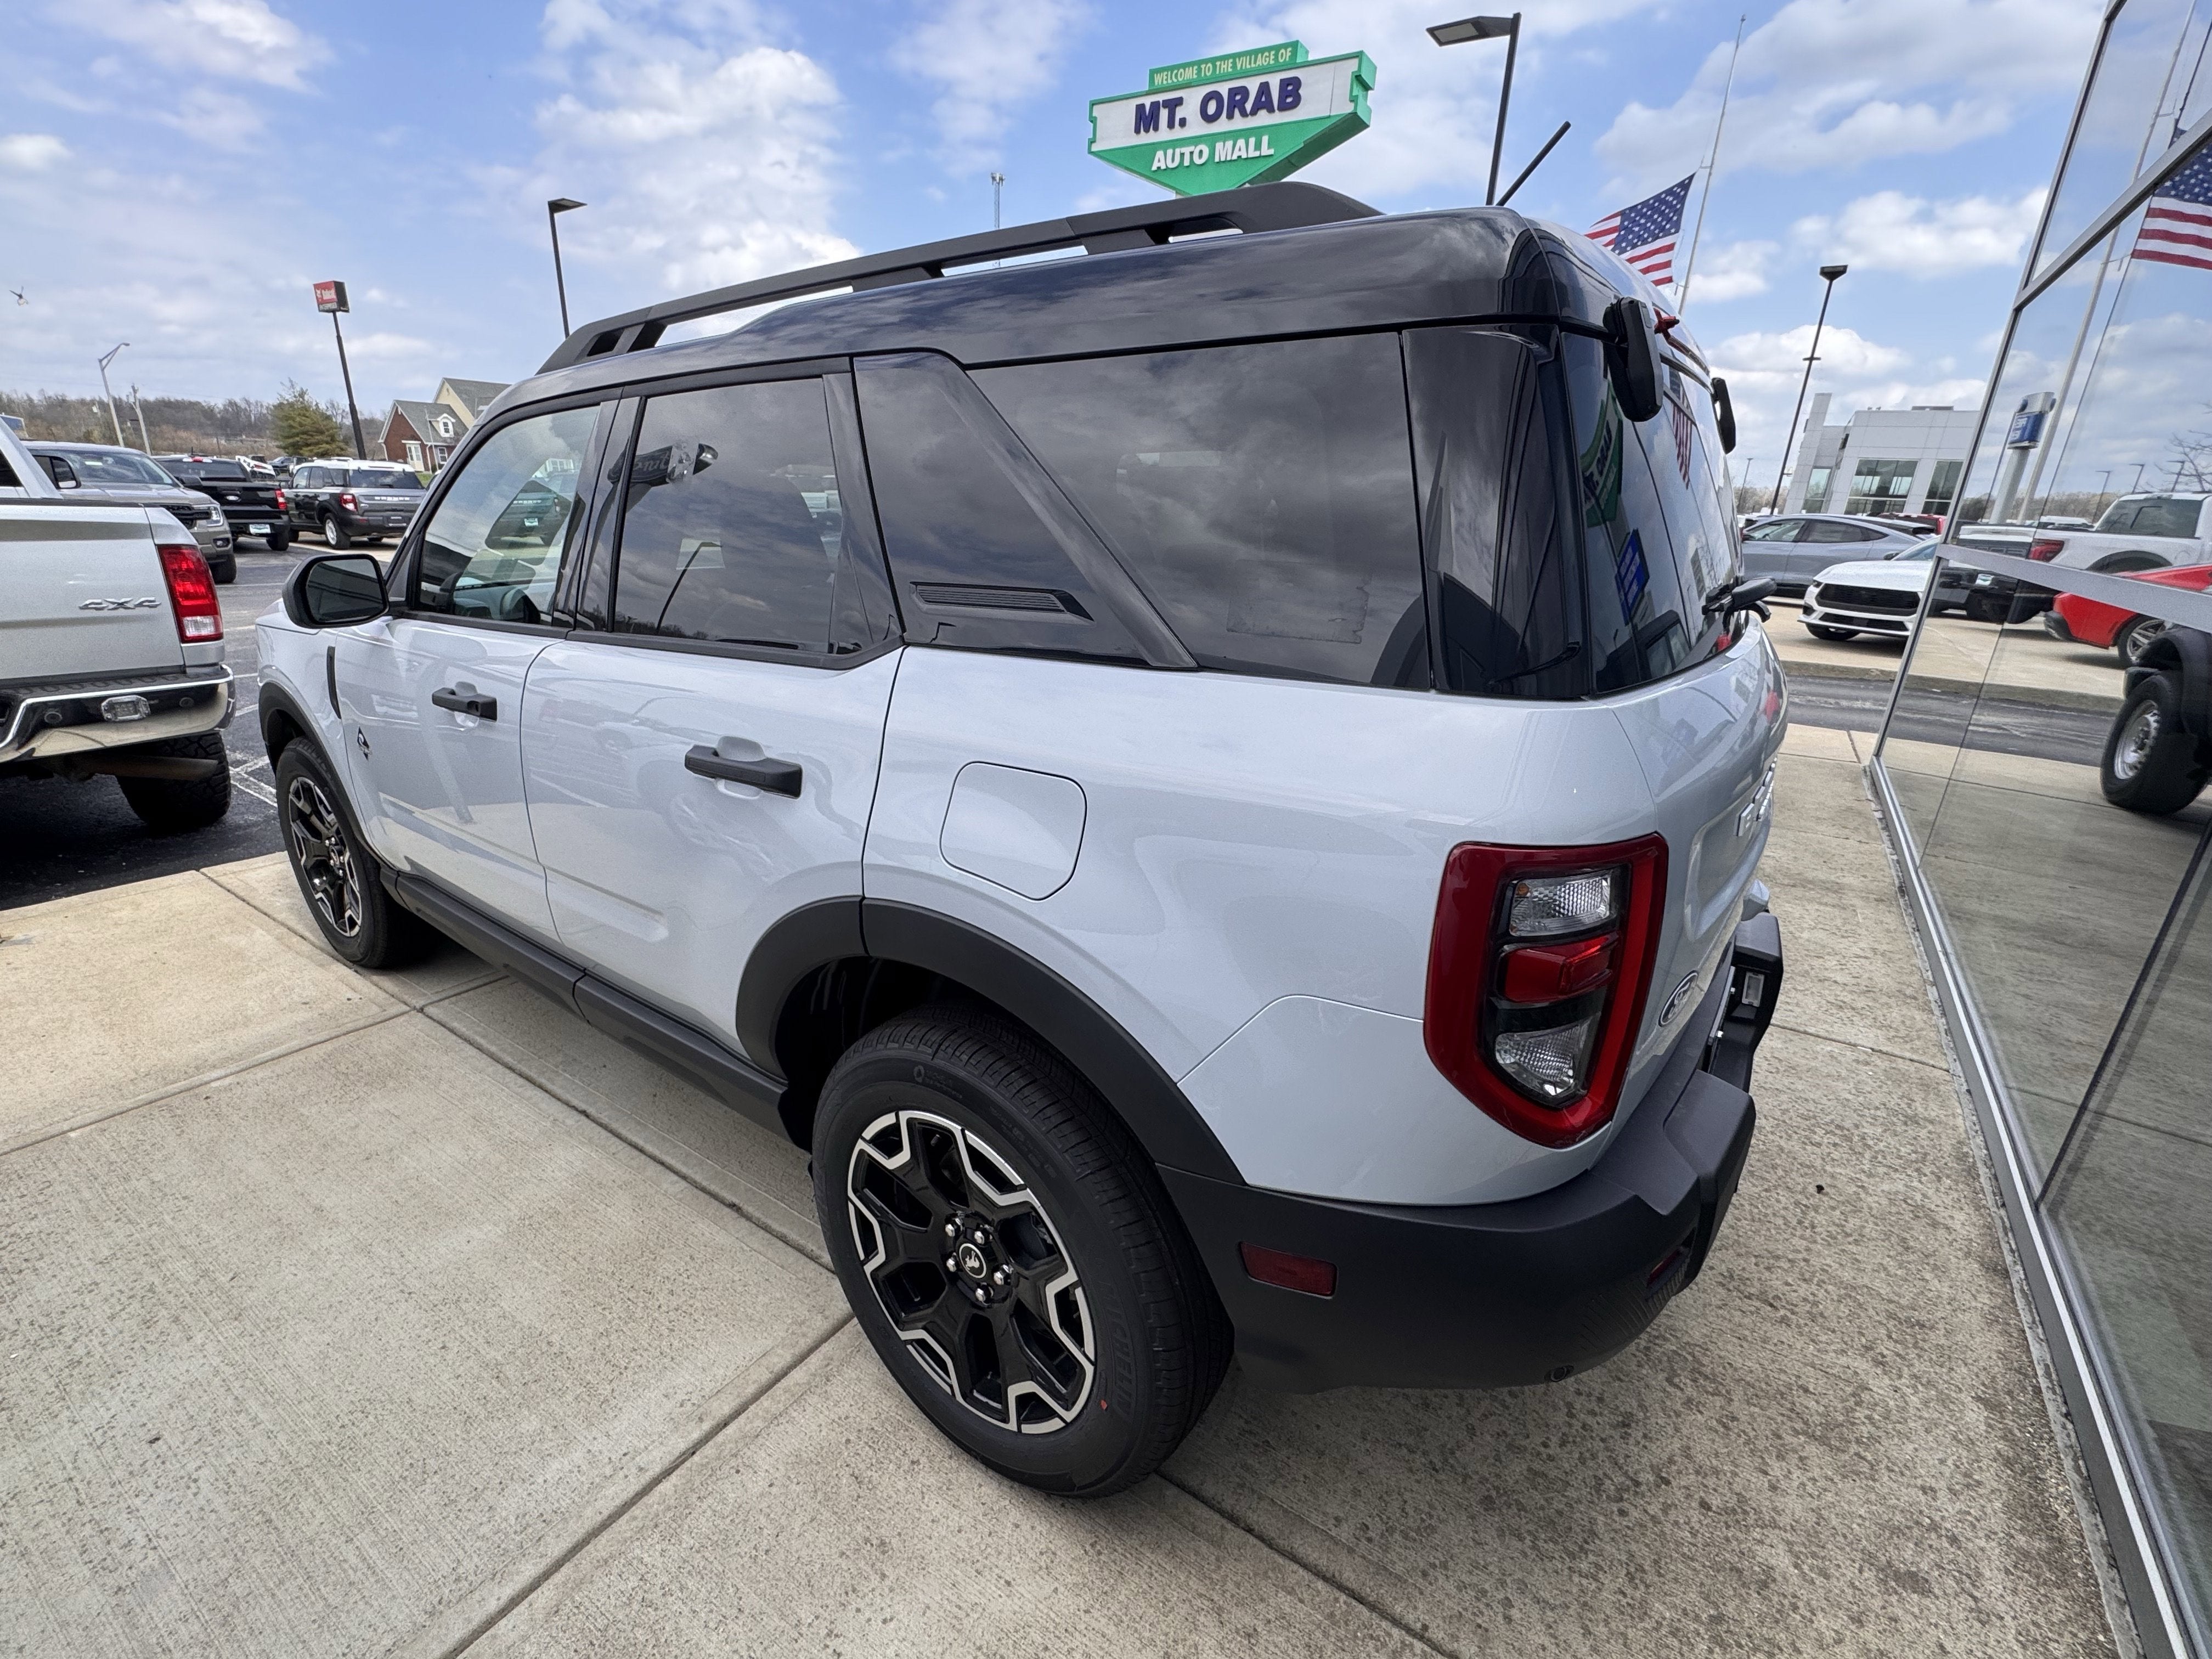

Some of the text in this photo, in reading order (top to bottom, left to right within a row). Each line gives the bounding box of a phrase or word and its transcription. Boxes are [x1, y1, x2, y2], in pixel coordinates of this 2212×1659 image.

[1154, 47, 1292, 86] WELCOME TO THE VILLAGE OF
[1134, 76, 1302, 134] MT. ORAB
[1151, 135, 1274, 171] AUTO MALL
